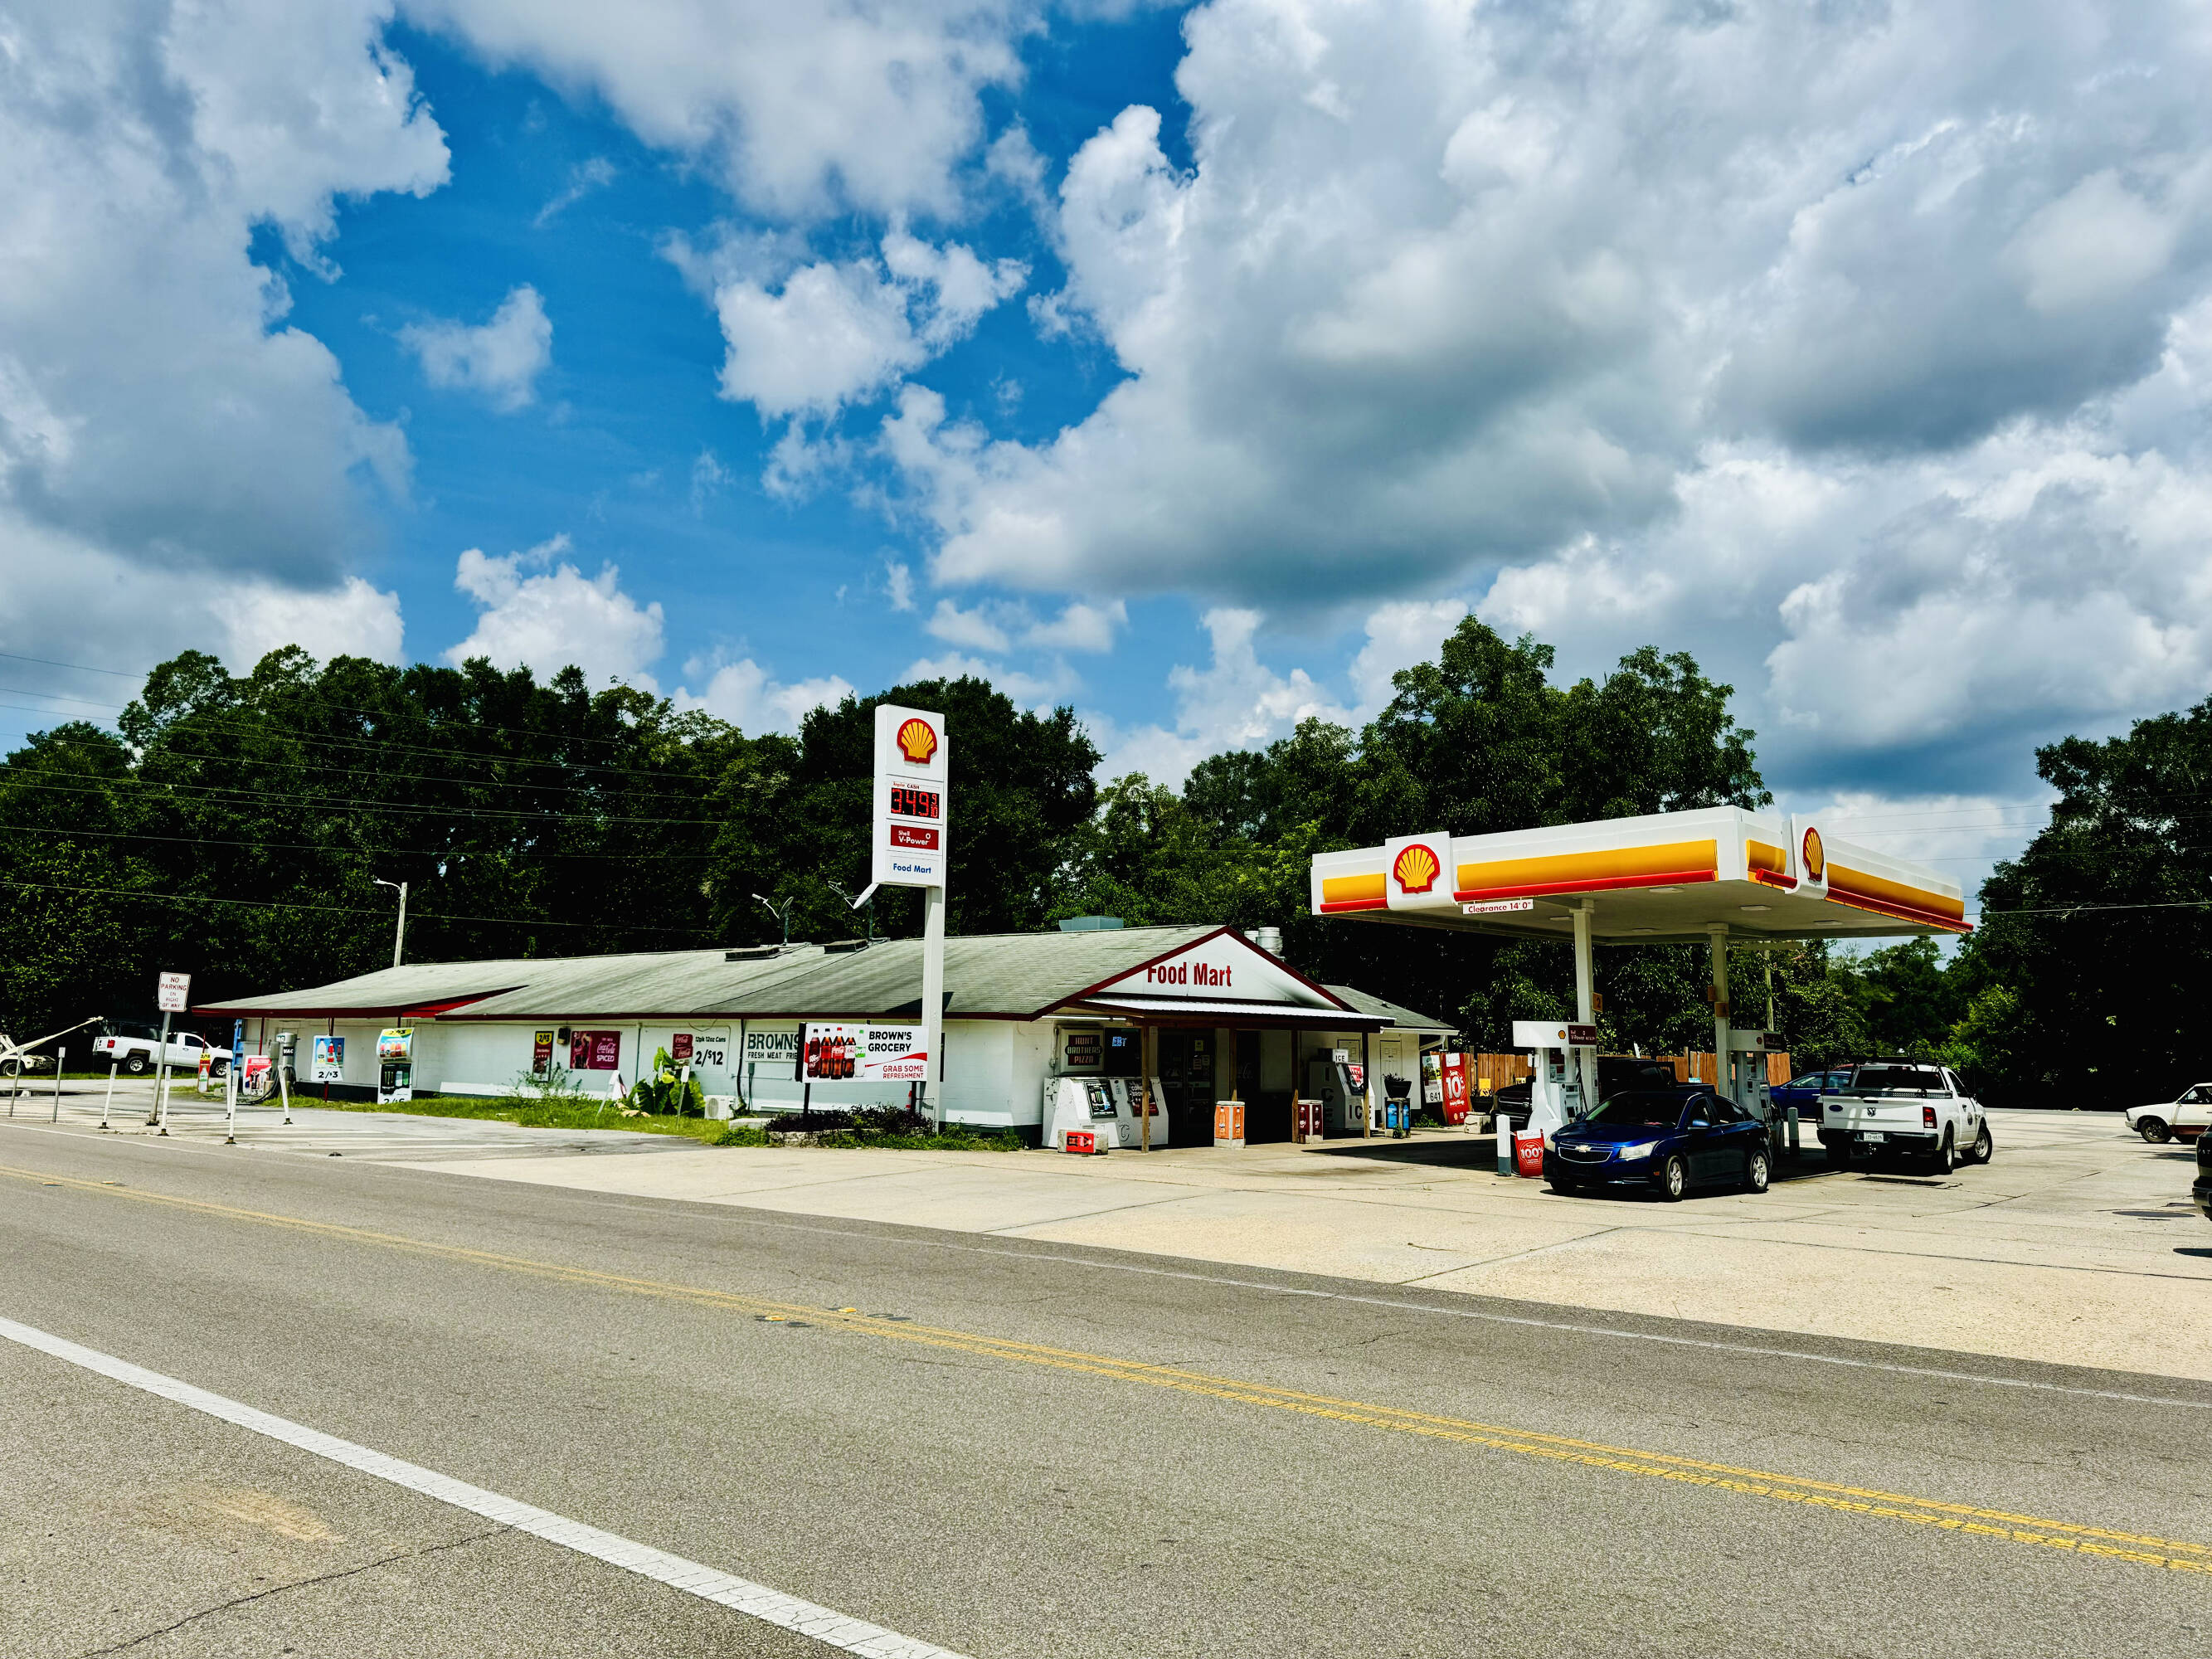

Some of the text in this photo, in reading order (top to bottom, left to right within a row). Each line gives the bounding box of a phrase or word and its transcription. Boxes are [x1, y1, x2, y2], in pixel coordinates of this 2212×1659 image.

[898, 836, 928, 845] V-Power
[892, 863, 931, 874] Food Mart
[1468, 905, 1507, 913] Clearance
[1147, 962, 1232, 987] Food Mart
[160, 983, 187, 991] PARKING
[868, 1031, 912, 1040] BROWN'S
[1111, 1036, 1127, 1047] EBT
[868, 1043, 911, 1052] GROCERY
[1067, 1046, 1101, 1054] BROTHERS
[596, 1054, 615, 1063] SPICED
[694, 1049, 723, 1068] 2/$12
[747, 1051, 765, 1059] FRESH
[1074, 1055, 1094, 1063] PIZZA
